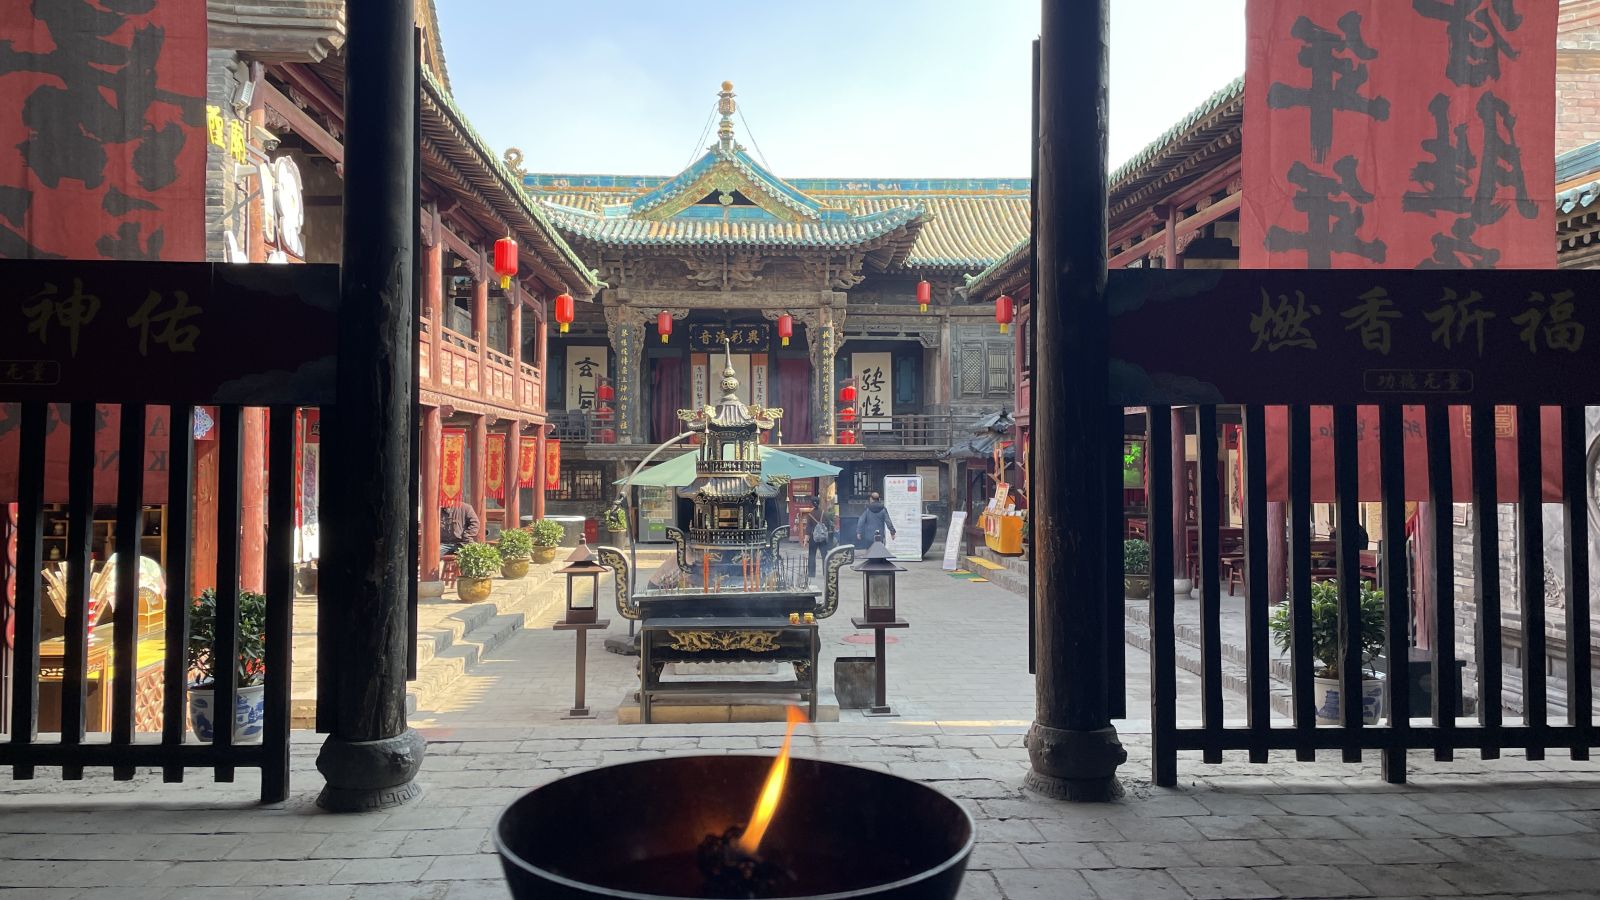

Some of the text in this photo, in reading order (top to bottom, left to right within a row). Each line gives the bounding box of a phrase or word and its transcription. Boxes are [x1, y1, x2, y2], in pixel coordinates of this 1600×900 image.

[22, 277, 204, 358] 神佑
[1249, 286, 1586, 358] 燃香祈福
